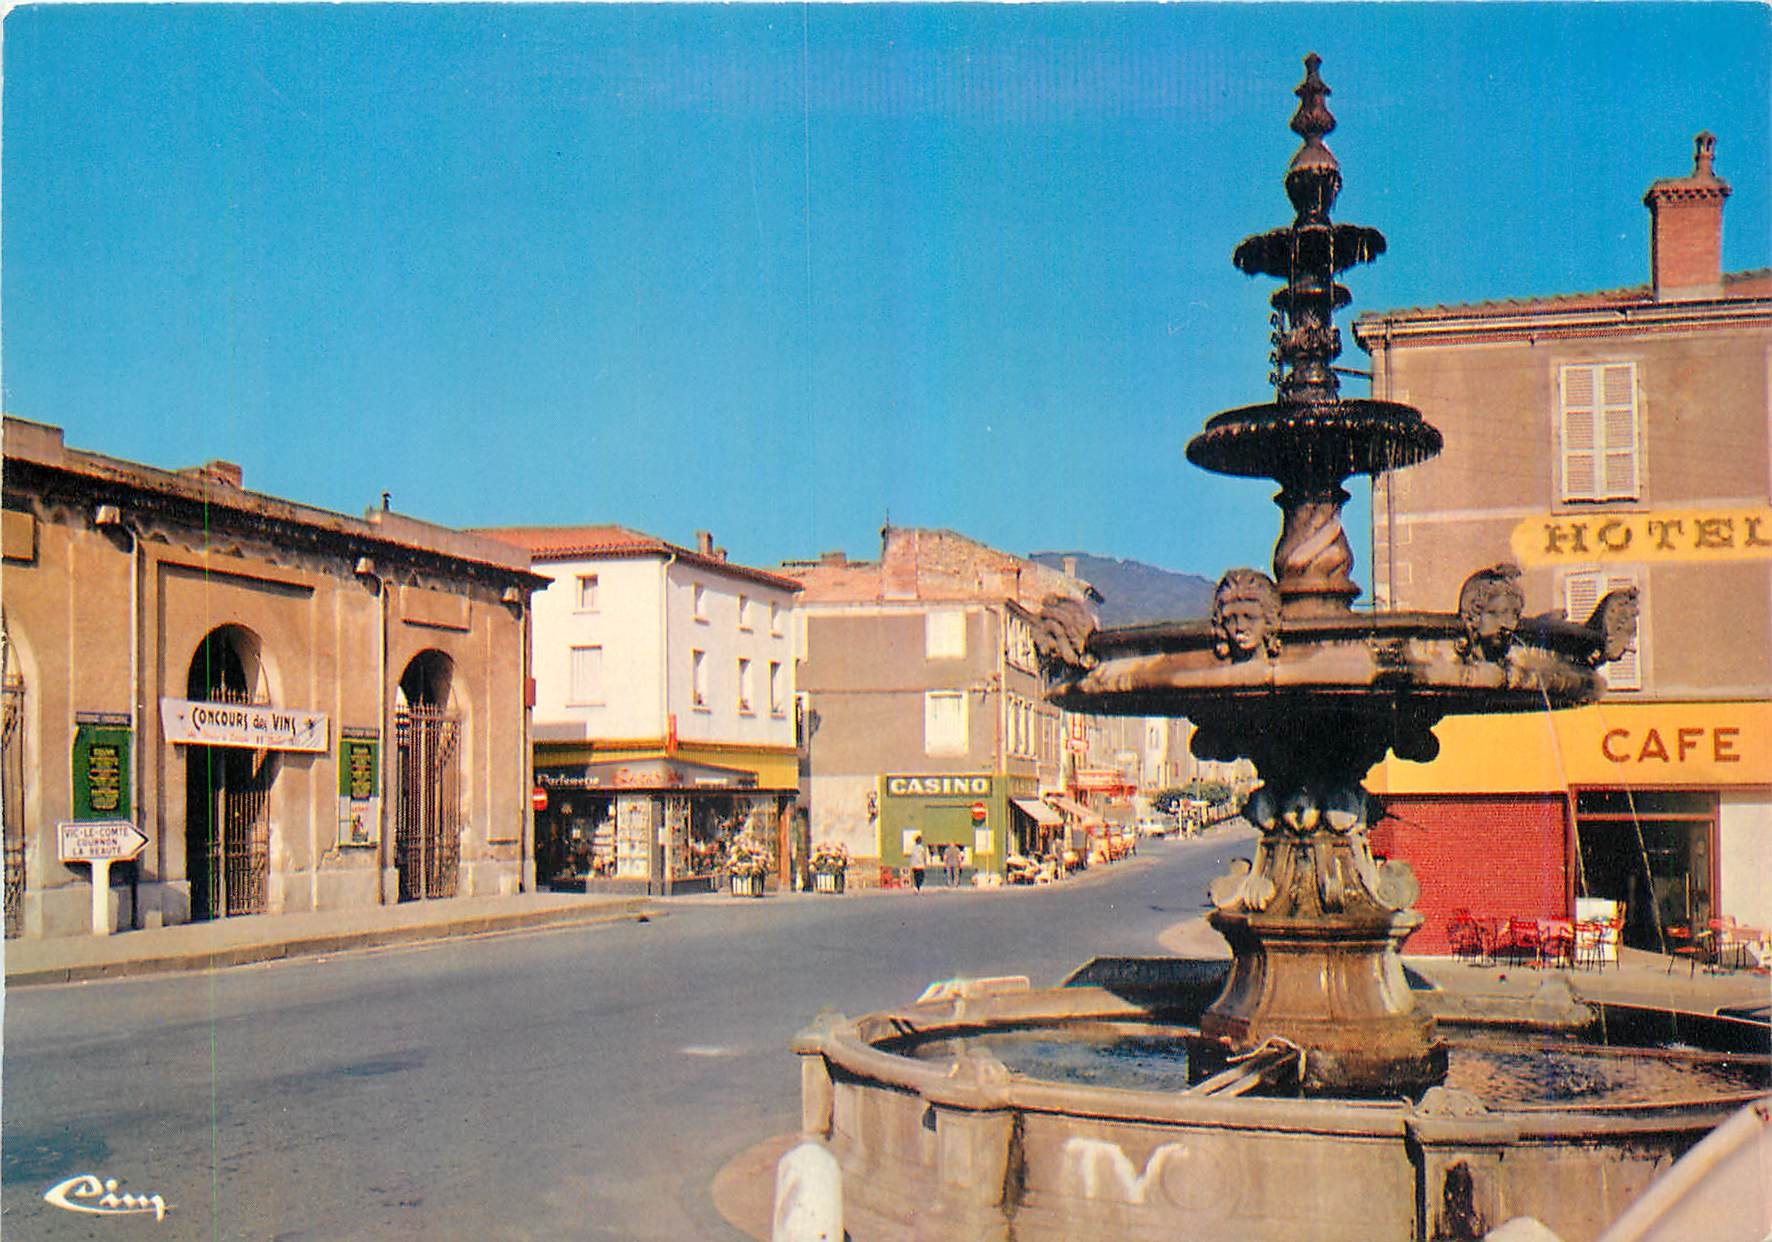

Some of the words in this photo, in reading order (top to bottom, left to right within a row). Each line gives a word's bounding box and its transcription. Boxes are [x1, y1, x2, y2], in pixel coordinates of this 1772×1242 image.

[1544, 516, 1772, 554] HOTEL
[192, 707, 248, 731] CONCOURS
[272, 713, 297, 736] VINS
[1602, 728, 1741, 763] CAFE
[889, 778, 990, 795] CASINO
